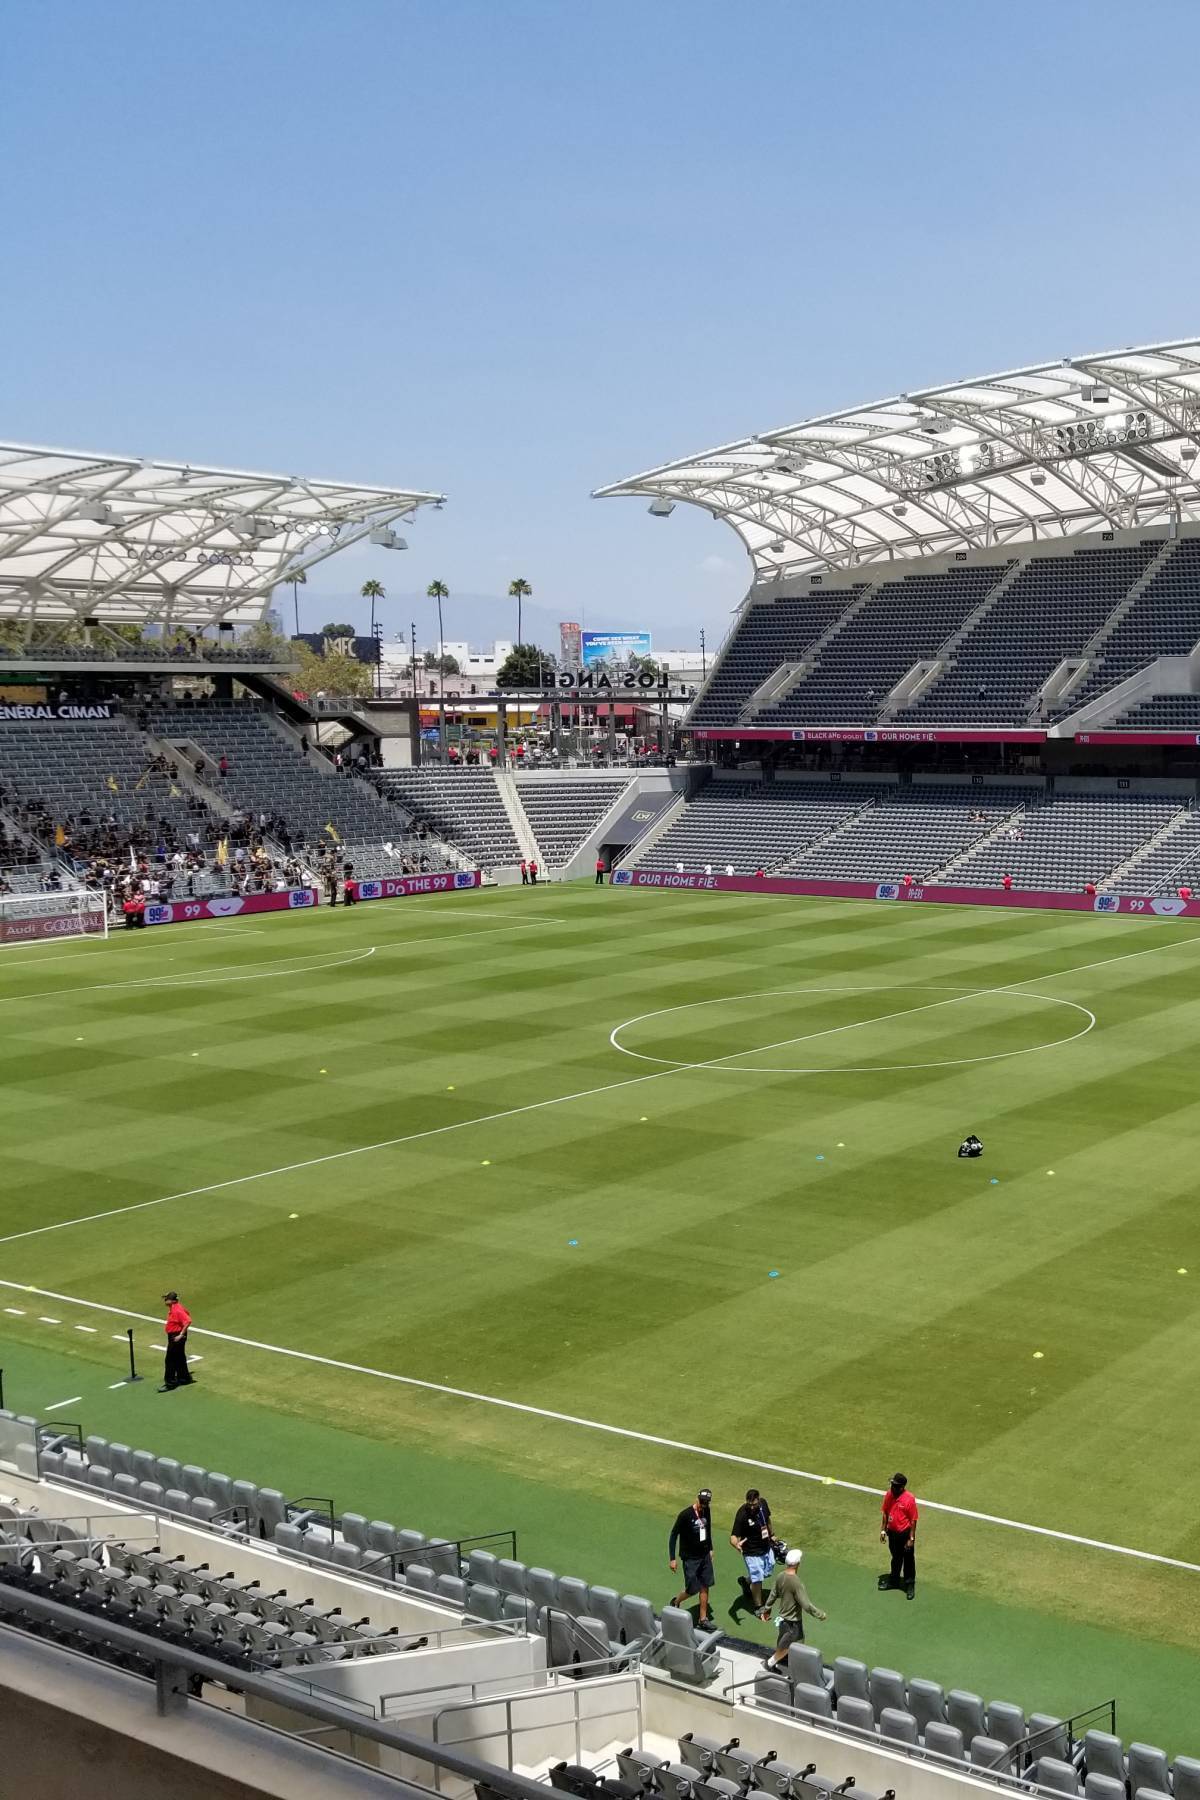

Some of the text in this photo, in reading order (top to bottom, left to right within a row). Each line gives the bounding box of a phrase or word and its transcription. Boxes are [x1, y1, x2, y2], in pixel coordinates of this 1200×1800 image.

[58, 705, 110, 718] CIMAN
[881, 732, 897, 740] OUR
[899, 732, 921, 740] HOME
[407, 879, 431, 892] THE
[433, 877, 447, 889] 99
[639, 873, 661, 885] OUR
[664, 875, 695, 886] HOME
[185, 905, 200, 917] 99
[1130, 900, 1144, 911] 99
